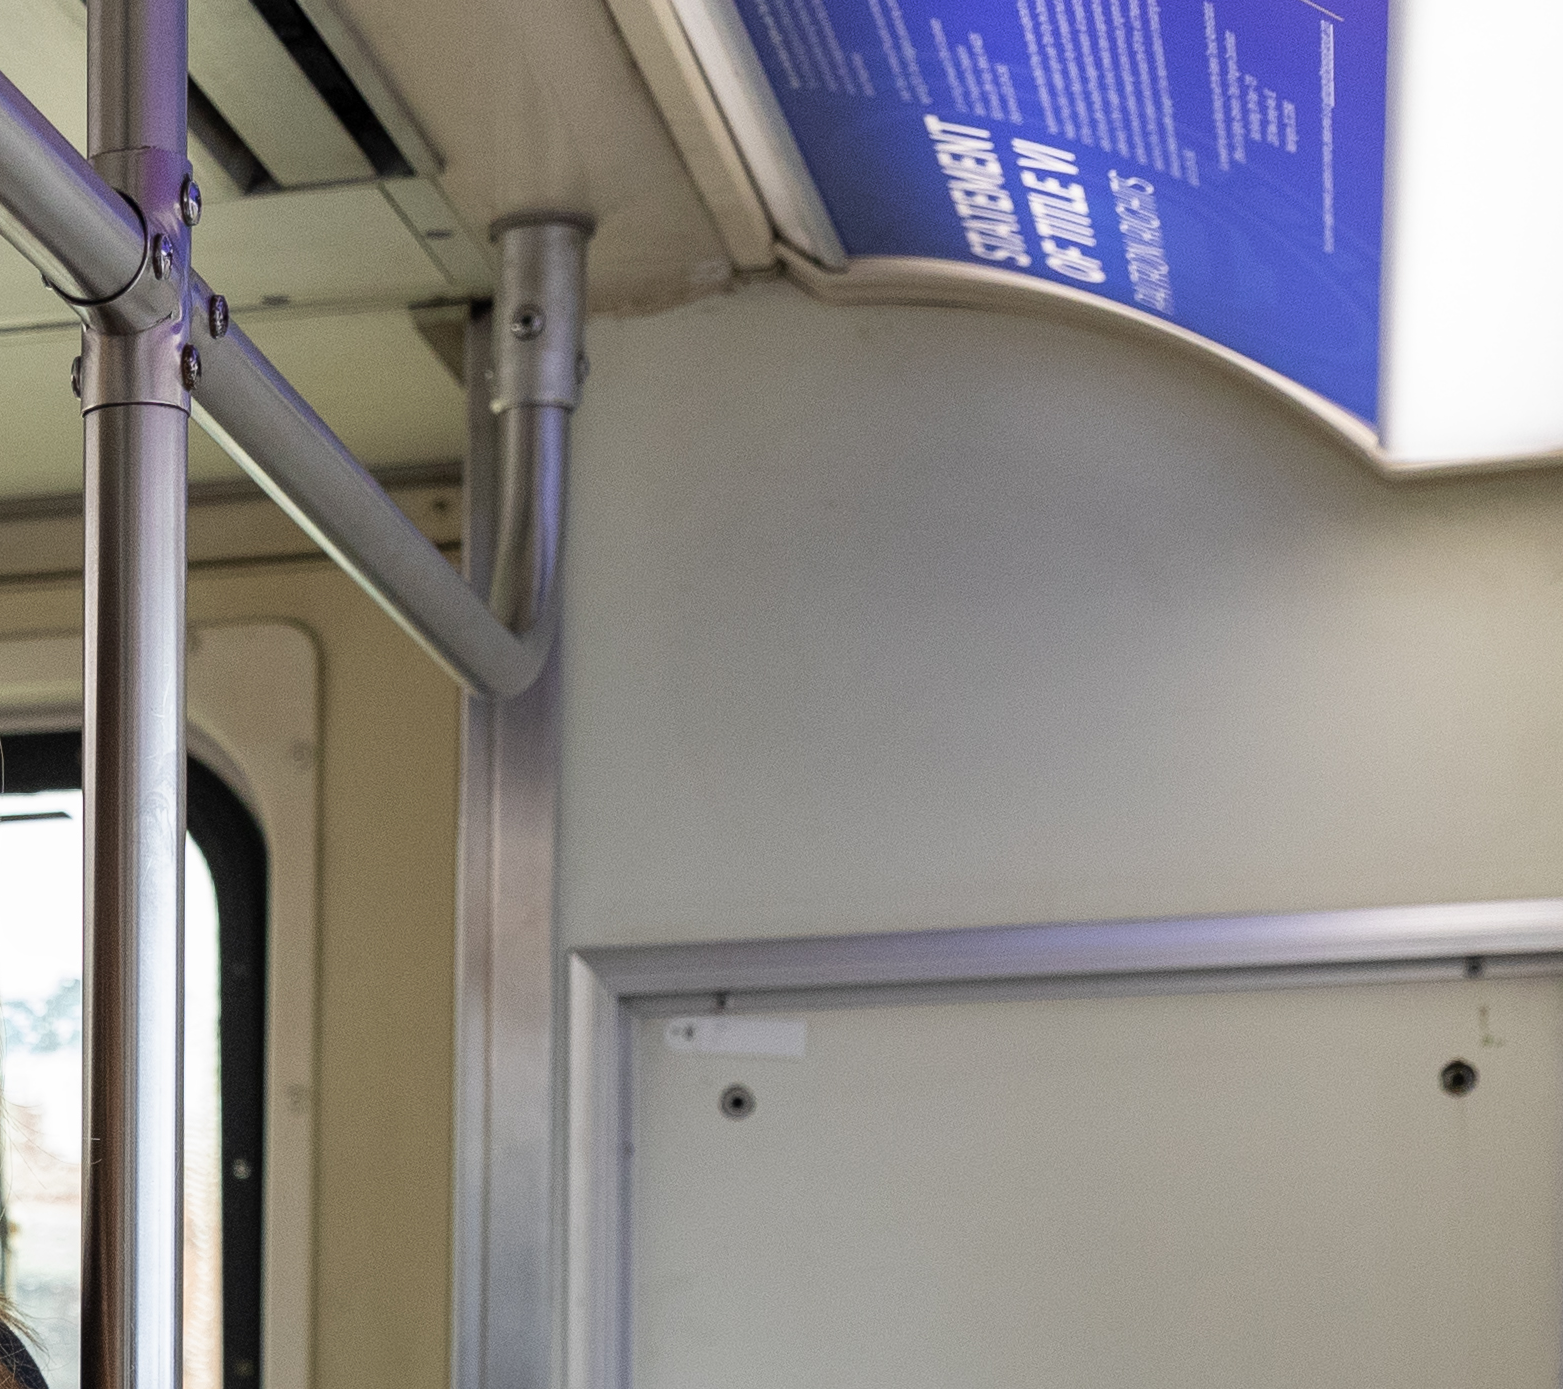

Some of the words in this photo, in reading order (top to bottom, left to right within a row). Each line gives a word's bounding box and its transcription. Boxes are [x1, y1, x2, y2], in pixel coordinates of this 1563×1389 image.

[924, 114, 1032, 267] STATEMENT
[1011, 137, 1079, 176] VI
[1020, 169, 1097, 247] TITLE
[1107, 169, 1162, 245] RIGHTS
[1040, 238, 1106, 283] OF
[1125, 240, 1174, 316] PATRON
